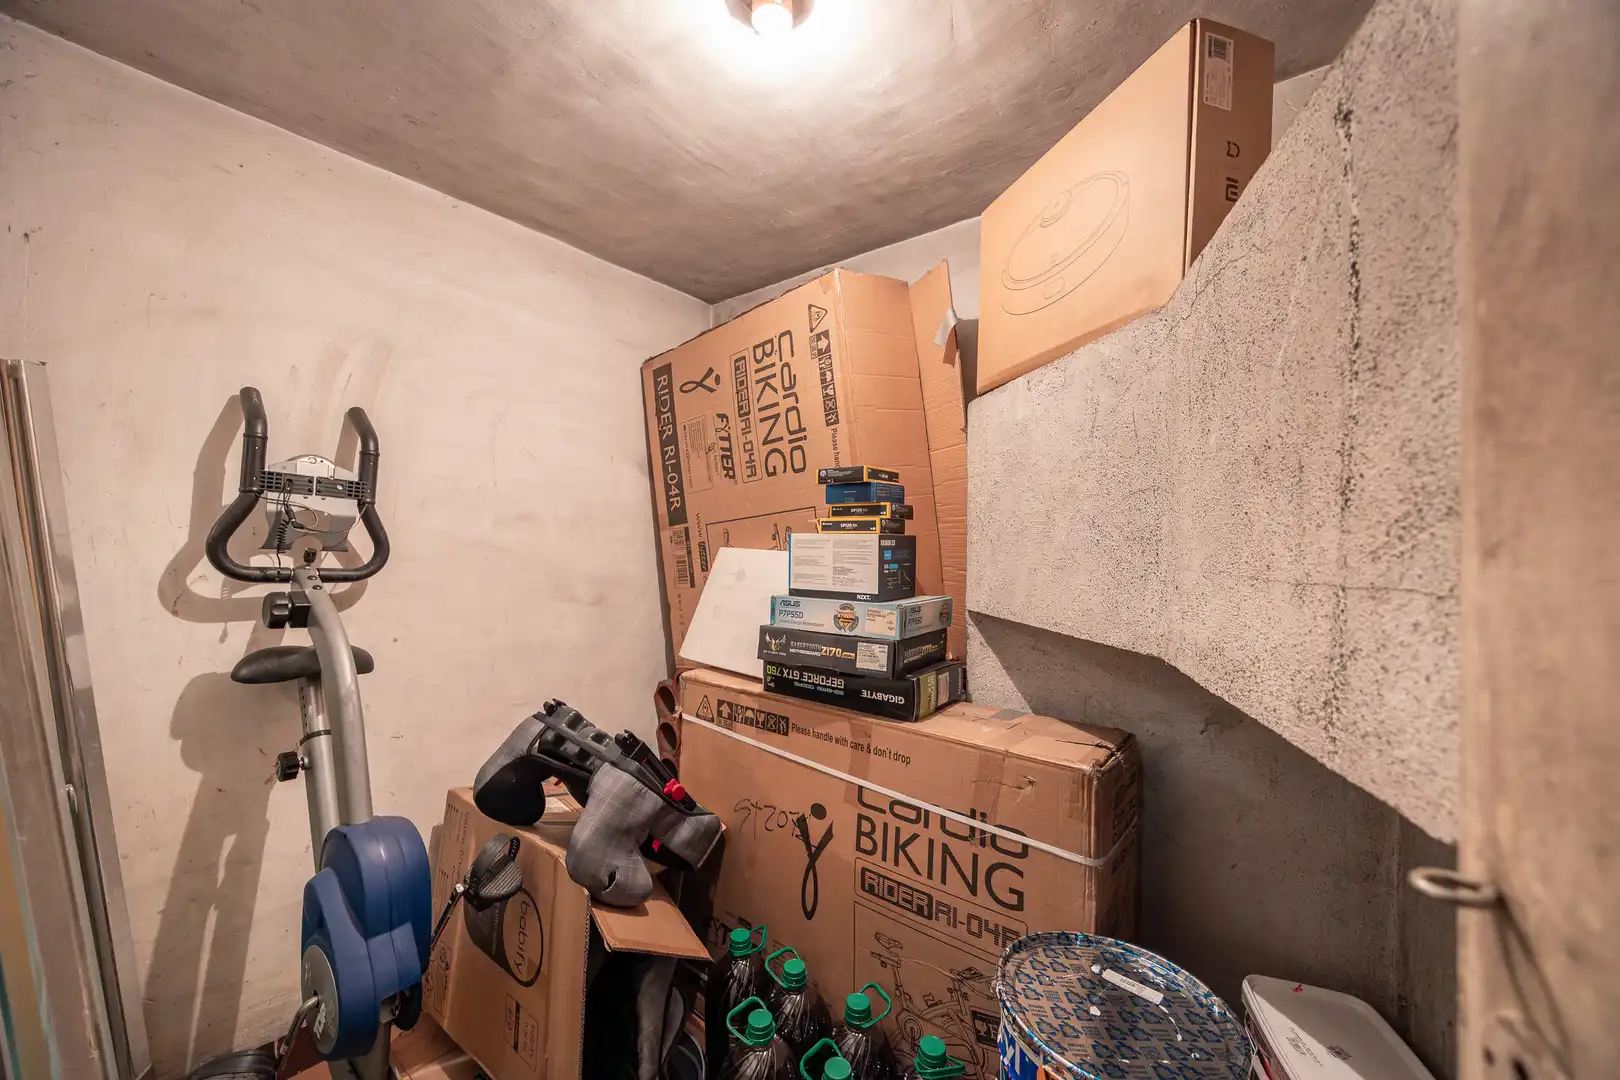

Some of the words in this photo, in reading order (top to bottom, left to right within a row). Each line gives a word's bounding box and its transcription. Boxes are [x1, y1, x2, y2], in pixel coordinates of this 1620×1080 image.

[657, 374, 673, 440] RIDER
[735, 358, 750, 415] RIDER
[753, 337, 787, 477] BIKING
[778, 329, 807, 474] Cardio
[715, 413, 736, 480] FYTTER
[740, 417, 757, 478] RI-04R
[831, 428, 839, 452] Please
[664, 445, 681, 511] RI-04R
[778, 609, 804, 619] P7P55D
[779, 599, 801, 608] ASUS
[766, 665, 781, 677] 760
[782, 668, 800, 680] GTX
[803, 672, 845, 689] GEFORCE
[821, 646, 842, 658] Z170
[861, 690, 905, 705] GIGABYTE
[791, 722, 811, 737] Please
[811, 728, 834, 743] handle
[834, 736, 849, 748] with
[849, 741, 865, 752] care
[866, 743, 871, 754] &
[872, 746, 892, 760] don't
[893, 750, 911, 767] drop
[855, 813, 1024, 911] BIKING
[513, 900, 531, 976] babify
[864, 872, 929, 917] RIDER
[935, 899, 1021, 949] RI-04R
